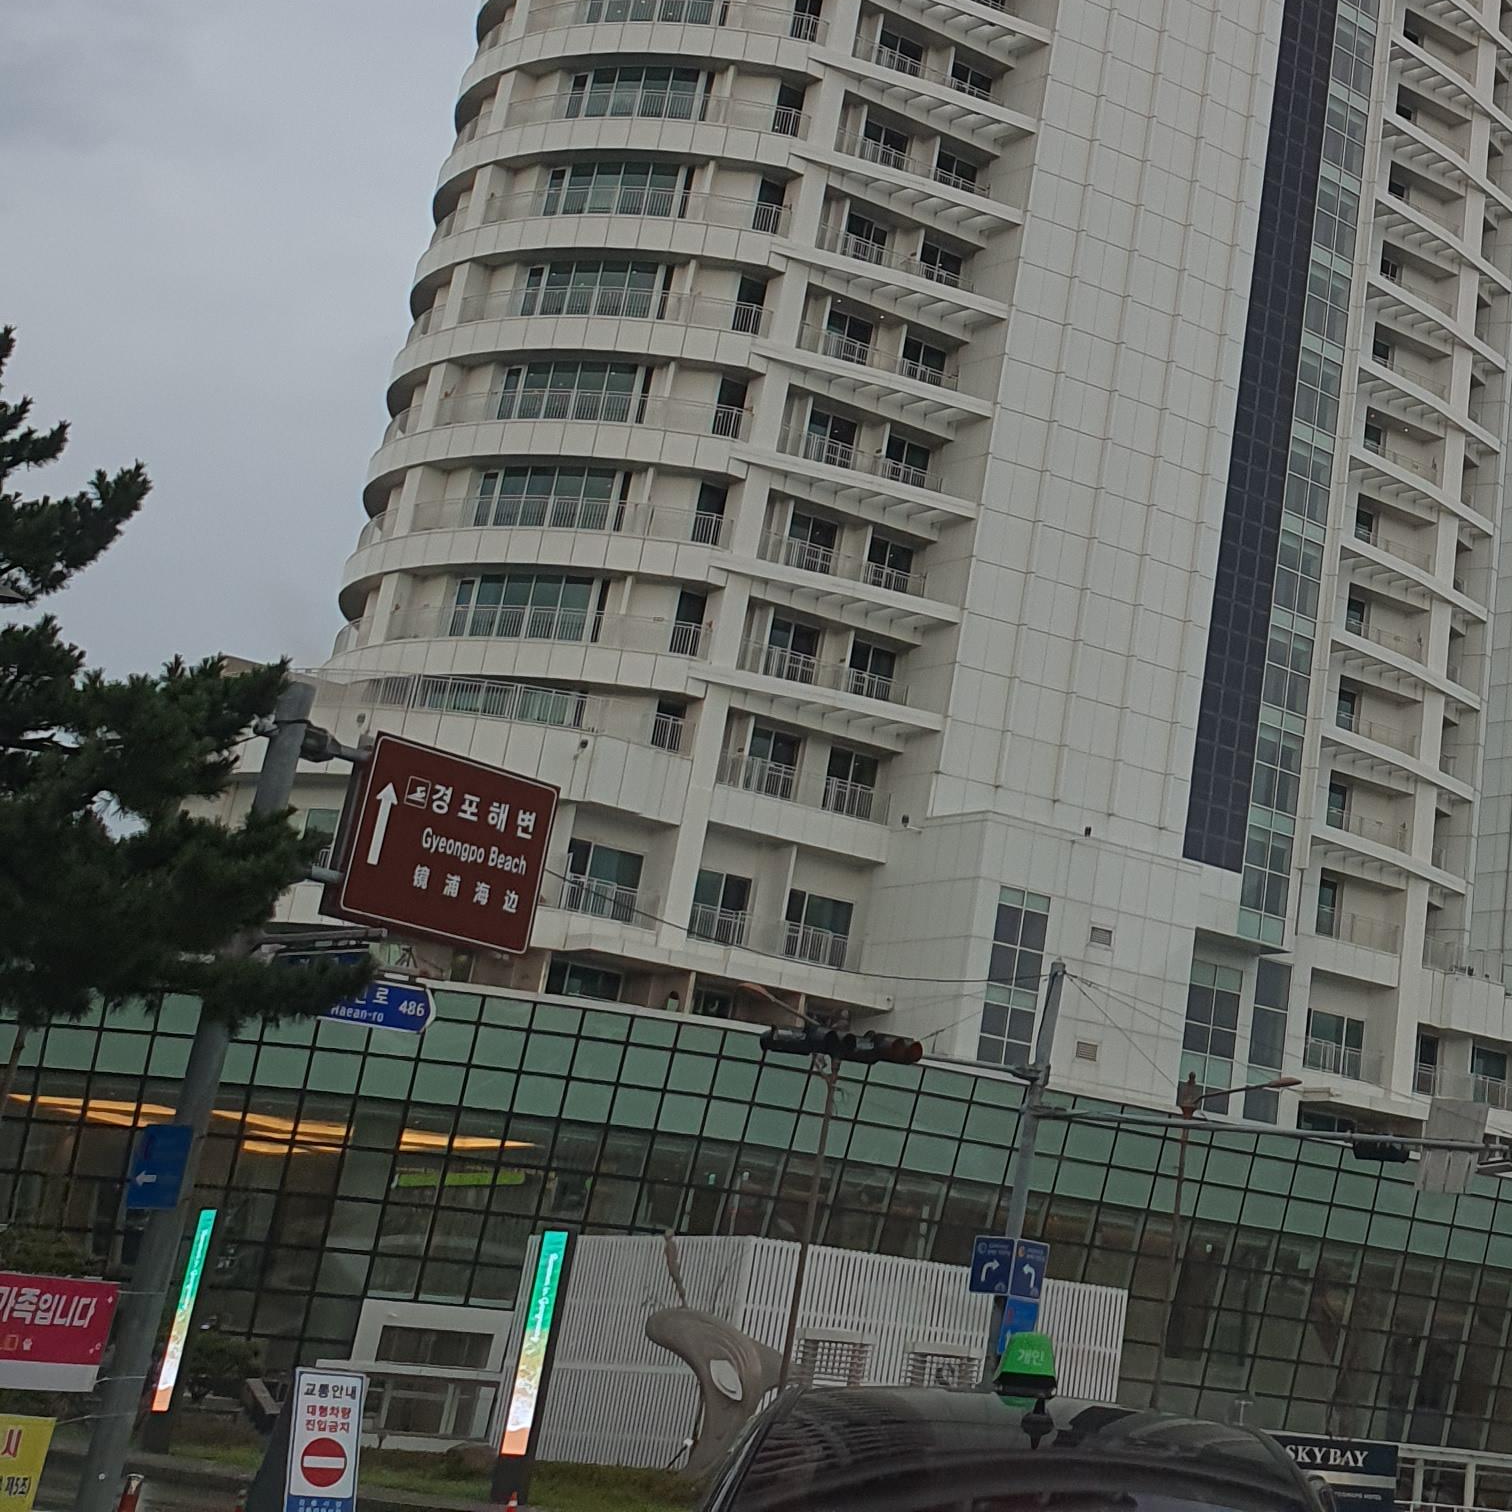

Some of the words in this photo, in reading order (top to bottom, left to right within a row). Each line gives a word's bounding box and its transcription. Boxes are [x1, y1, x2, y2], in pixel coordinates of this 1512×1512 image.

[432, 784, 536, 839] 경포해변
[422, 827, 485, 863] Gyeongpo
[488, 846, 527, 876] Beach
[330, 1006, 384, 1023] Haean-ro
[398, 1000, 425, 1017] 486
[0, 1286, 97, 1328] 가족입니다
[1017, 1349, 1045, 1366] 개인
[304, 1383, 357, 1400] 교통안내
[306, 1405, 352, 1419] 대형차량
[305, 1419, 350, 1433] 진입금지
